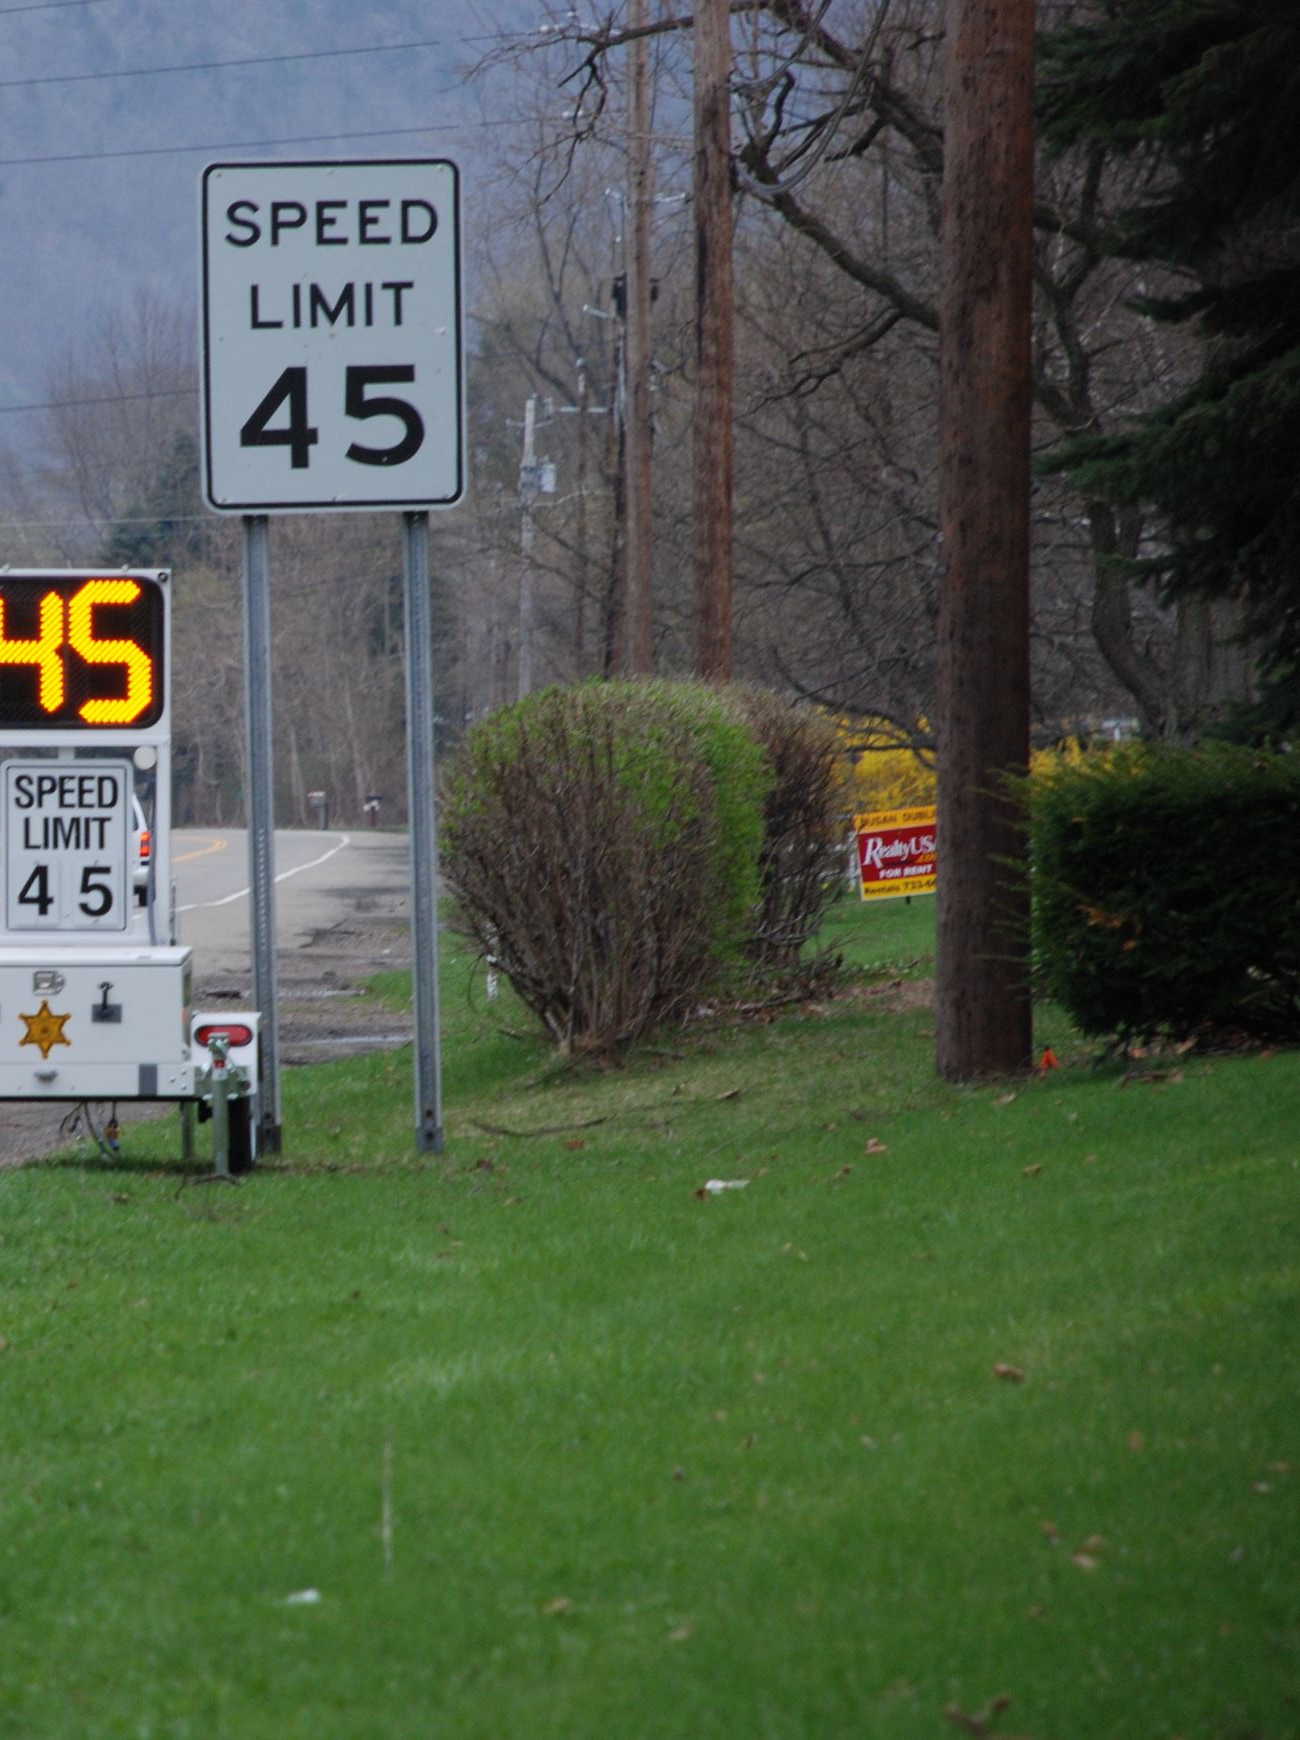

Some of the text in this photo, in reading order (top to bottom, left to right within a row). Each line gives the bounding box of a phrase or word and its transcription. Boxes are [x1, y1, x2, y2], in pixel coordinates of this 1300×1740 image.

[225, 199, 438, 247] SPEED
[251, 281, 414, 329] LIMIT
[240, 364, 425, 469] 45
[14, 774, 118, 809] SPEED
[24, 816, 112, 850] LIMIT
[879, 864, 933, 879] FOR RENT
